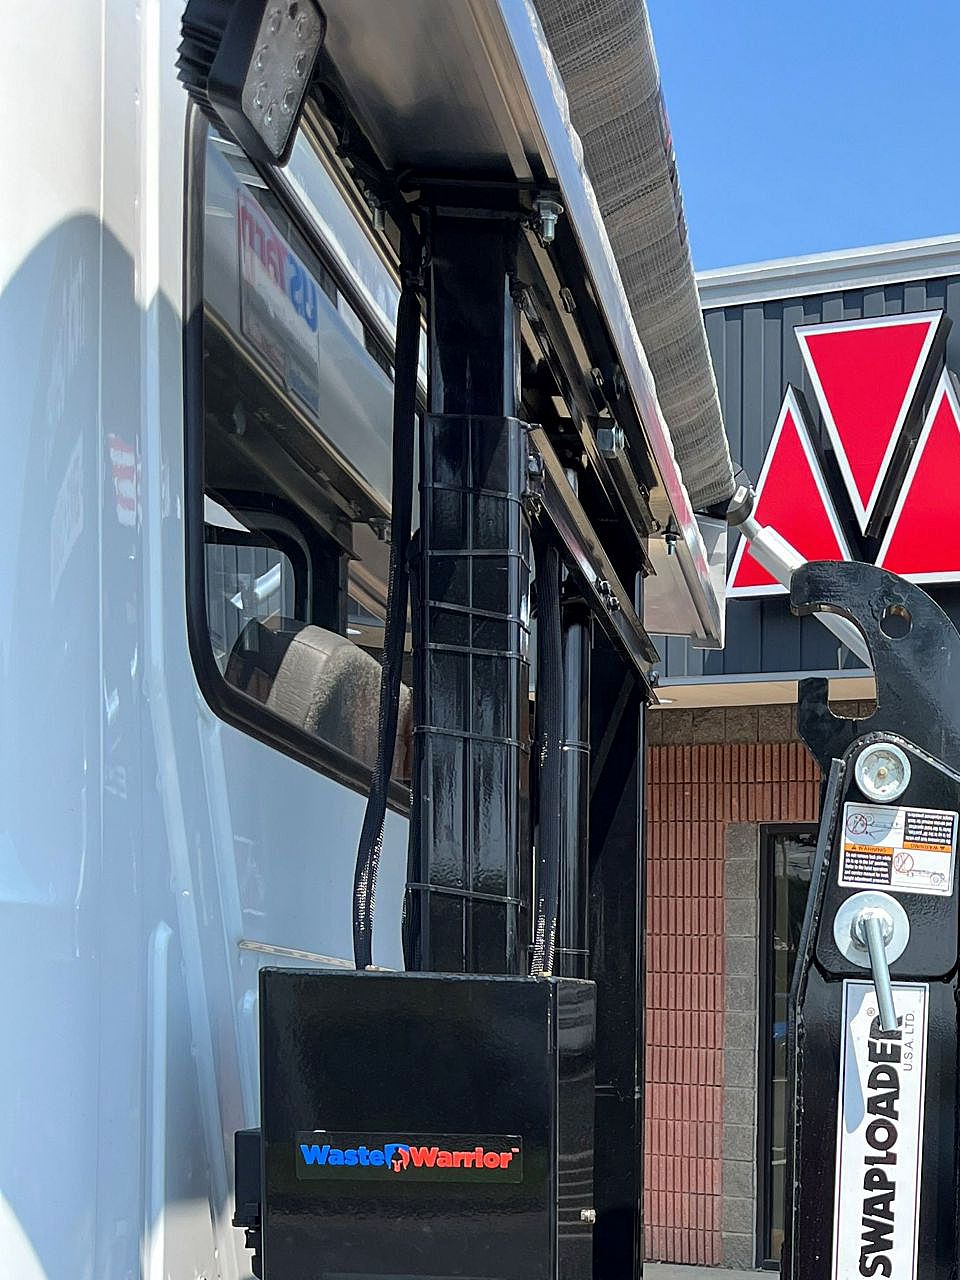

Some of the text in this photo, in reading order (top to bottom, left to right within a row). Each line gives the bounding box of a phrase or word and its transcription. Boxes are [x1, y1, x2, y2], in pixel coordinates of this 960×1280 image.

[300, 1144, 513, 1169] Waste Warrior
[858, 1014, 903, 1279] SWAPLOADER
